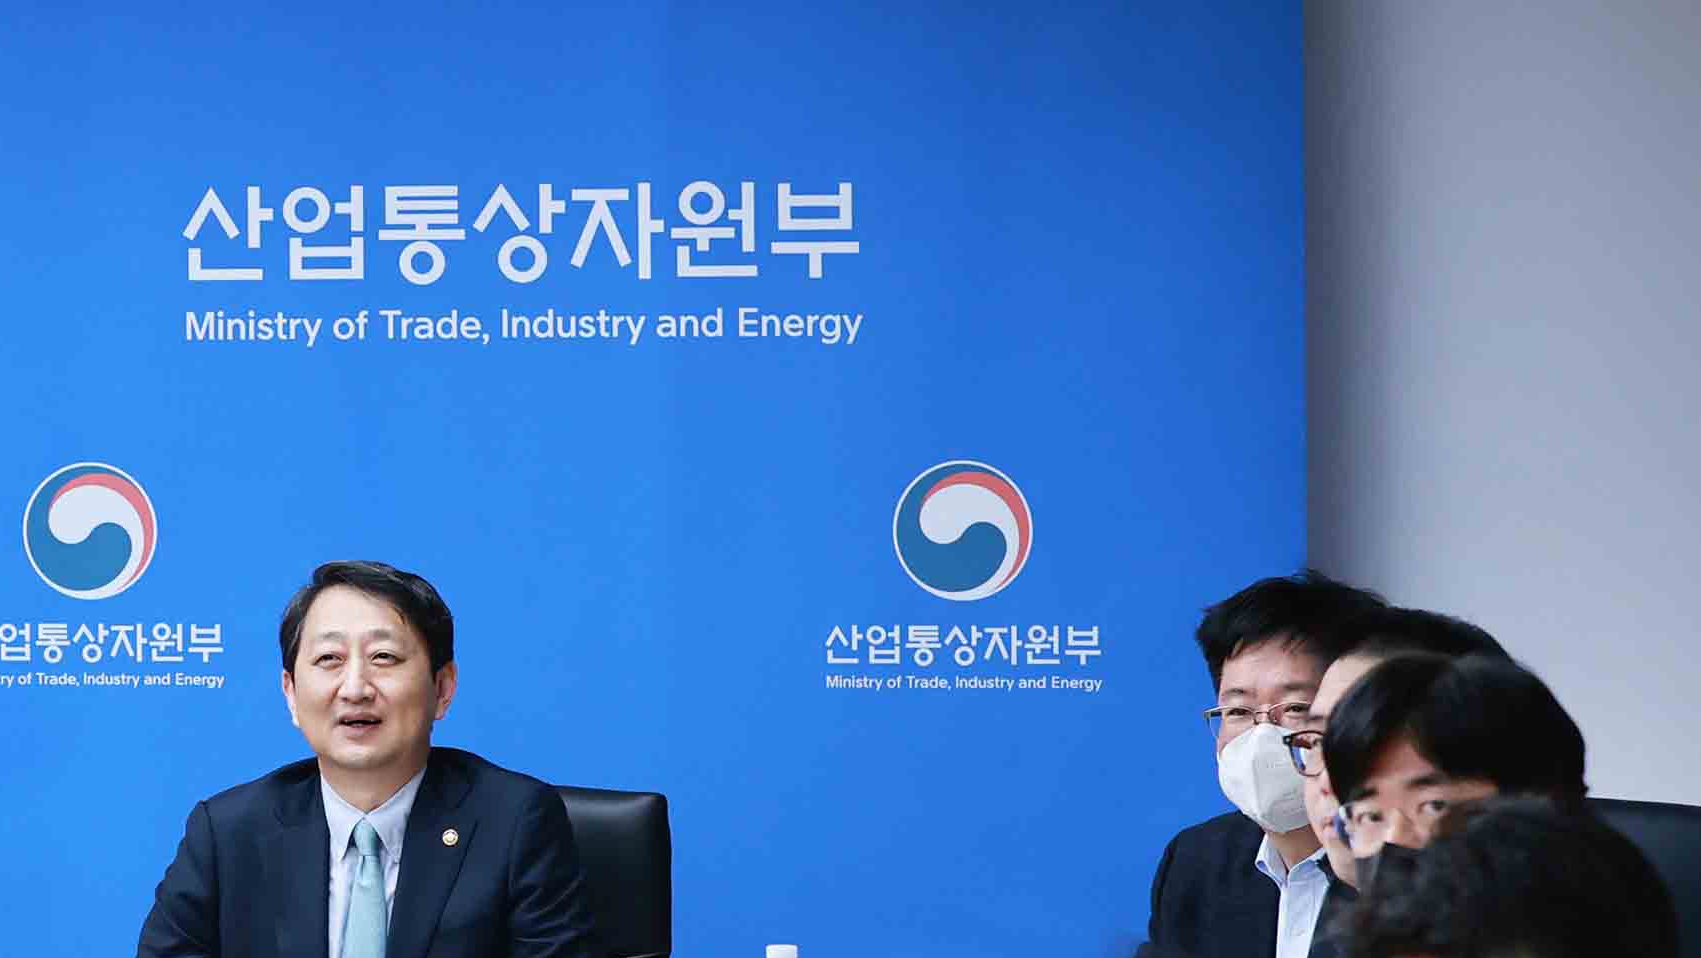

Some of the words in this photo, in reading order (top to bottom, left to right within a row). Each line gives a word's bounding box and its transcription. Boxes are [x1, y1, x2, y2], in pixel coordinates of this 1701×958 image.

[183, 181, 860, 285] 산업통상자원부
[186, 309, 322, 347] Ministry
[333, 309, 369, 340] of
[379, 309, 491, 344] Trade,
[502, 309, 646, 345] Industry
[656, 308, 724, 338] and
[739, 308, 864, 344] Energy
[825, 624, 1102, 667] 산업통상자원부
[17, 671, 33, 686] of
[35, 672, 80, 687] Trade,
[83, 671, 140, 689] Industry
[143, 672, 171, 686] and
[174, 672, 225, 689] Energy
[825, 674, 884, 691] Ministry
[886, 675, 903, 689] of
[905, 675, 952, 691] Trade,
[955, 675, 1015, 692] Industry
[1018, 675, 1047, 689] and
[1050, 675, 1103, 692] Energy
